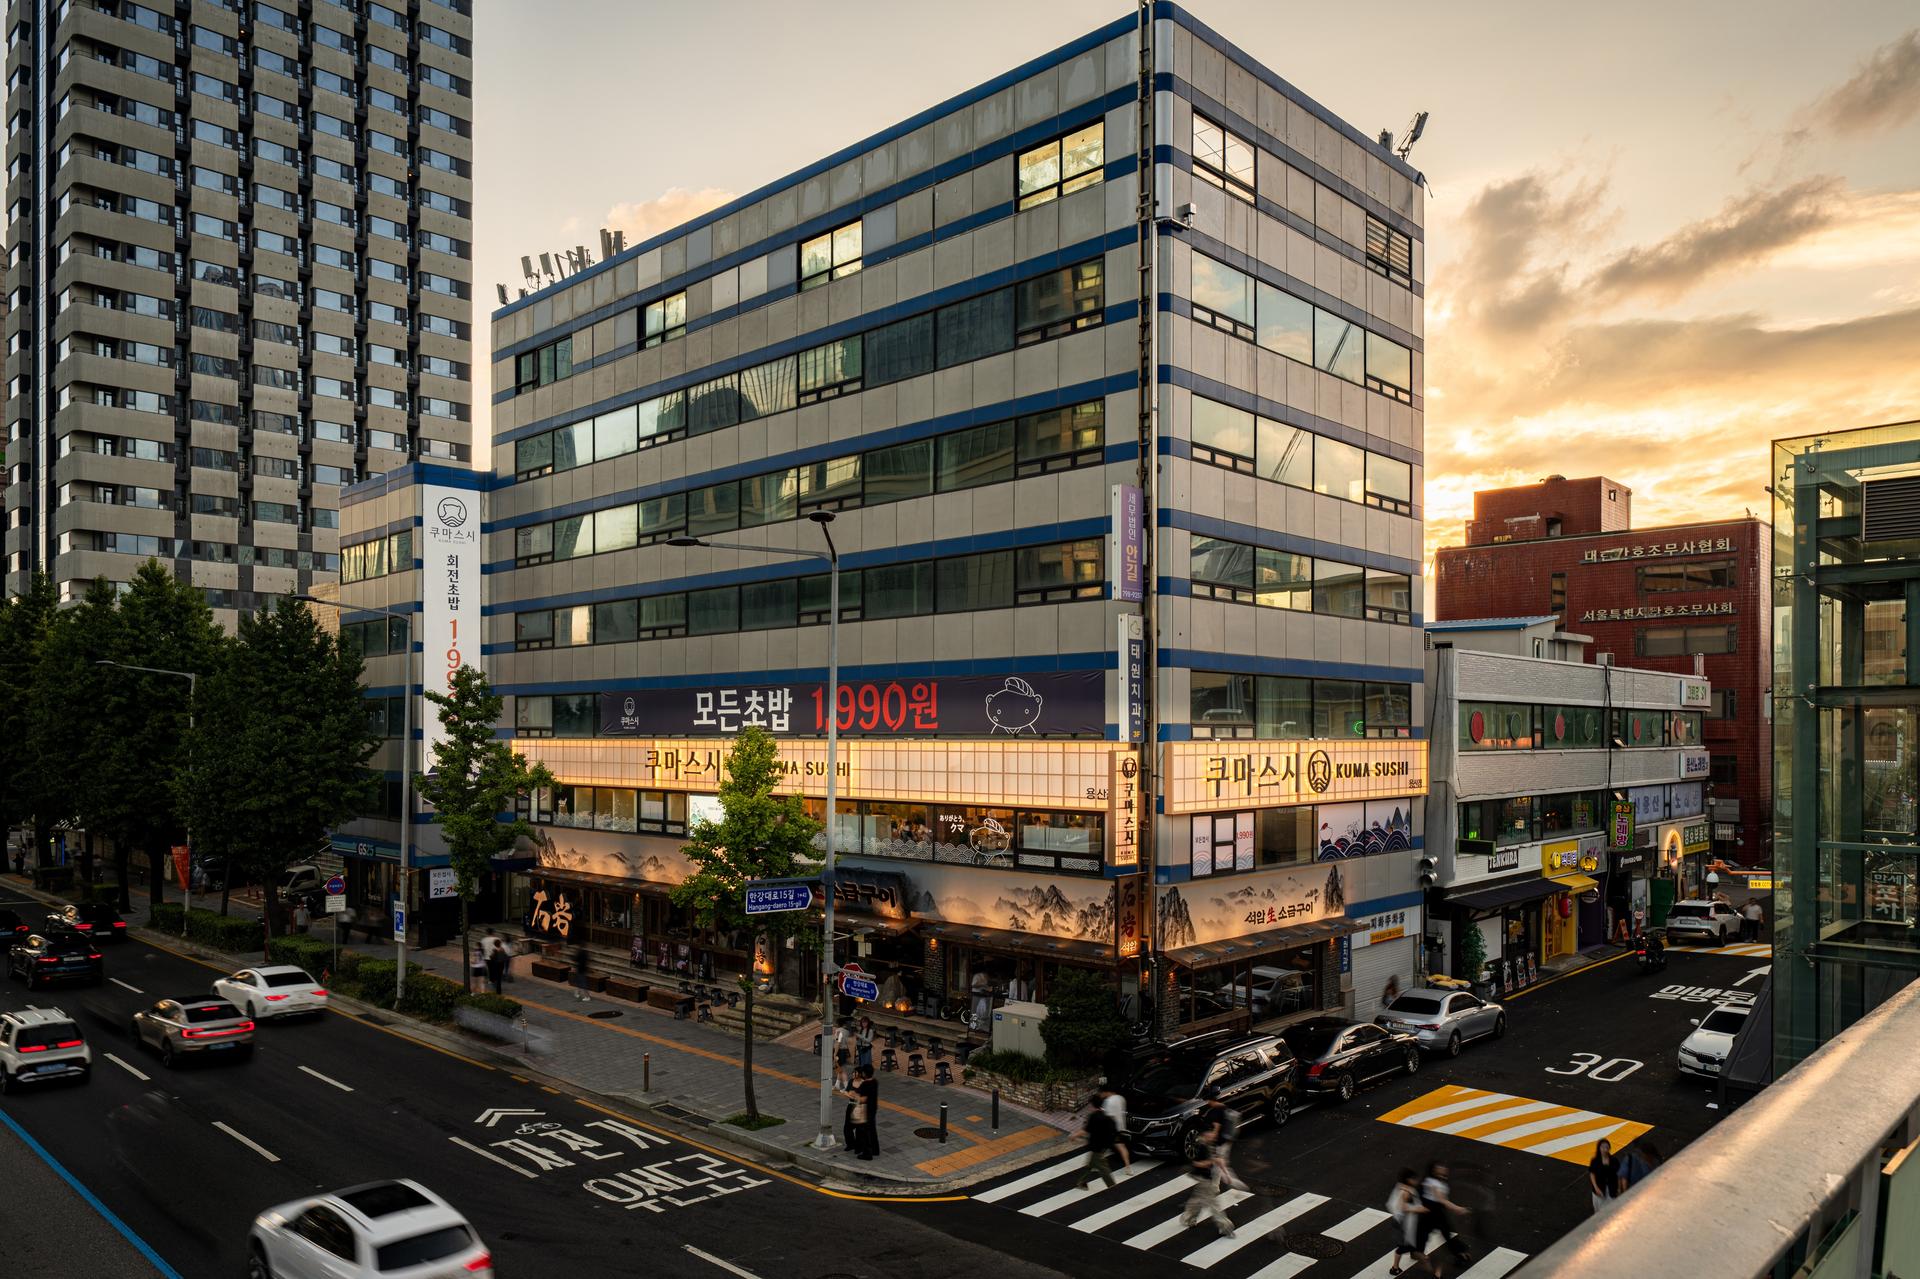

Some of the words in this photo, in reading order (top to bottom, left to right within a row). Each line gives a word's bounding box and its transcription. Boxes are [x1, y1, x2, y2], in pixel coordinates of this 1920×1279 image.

[429, 527, 476, 543] 쿠마스시
[446, 554, 460, 611] 회전초밥
[1131, 644, 1141, 718] 태원치과
[693, 687, 793, 732] 모든초밥
[811, 681, 939, 731] 1,990원
[645, 748, 721, 783] 쿠마스시
[805, 761, 850, 777] SUHI
[1206, 753, 1301, 798] 쿠마스시
[1335, 763, 1370, 779] KUMA
[1374, 760, 1409, 777] SUSHI
[1086, 788, 1109, 800] 용산
[1123, 782, 1135, 846] 쿠마스시
[950, 822, 965, 834] クマ
[357, 842, 375, 857] GS25
[433, 887, 445, 896] 2F
[749, 890, 795, 903] 한강대로15길
[748, 903, 787, 912] Hangang-daero
[788, 900, 802, 909] 15-gil
[1544, 1052, 1645, 1082] 30
[489, 1119, 672, 1171] 자전거
